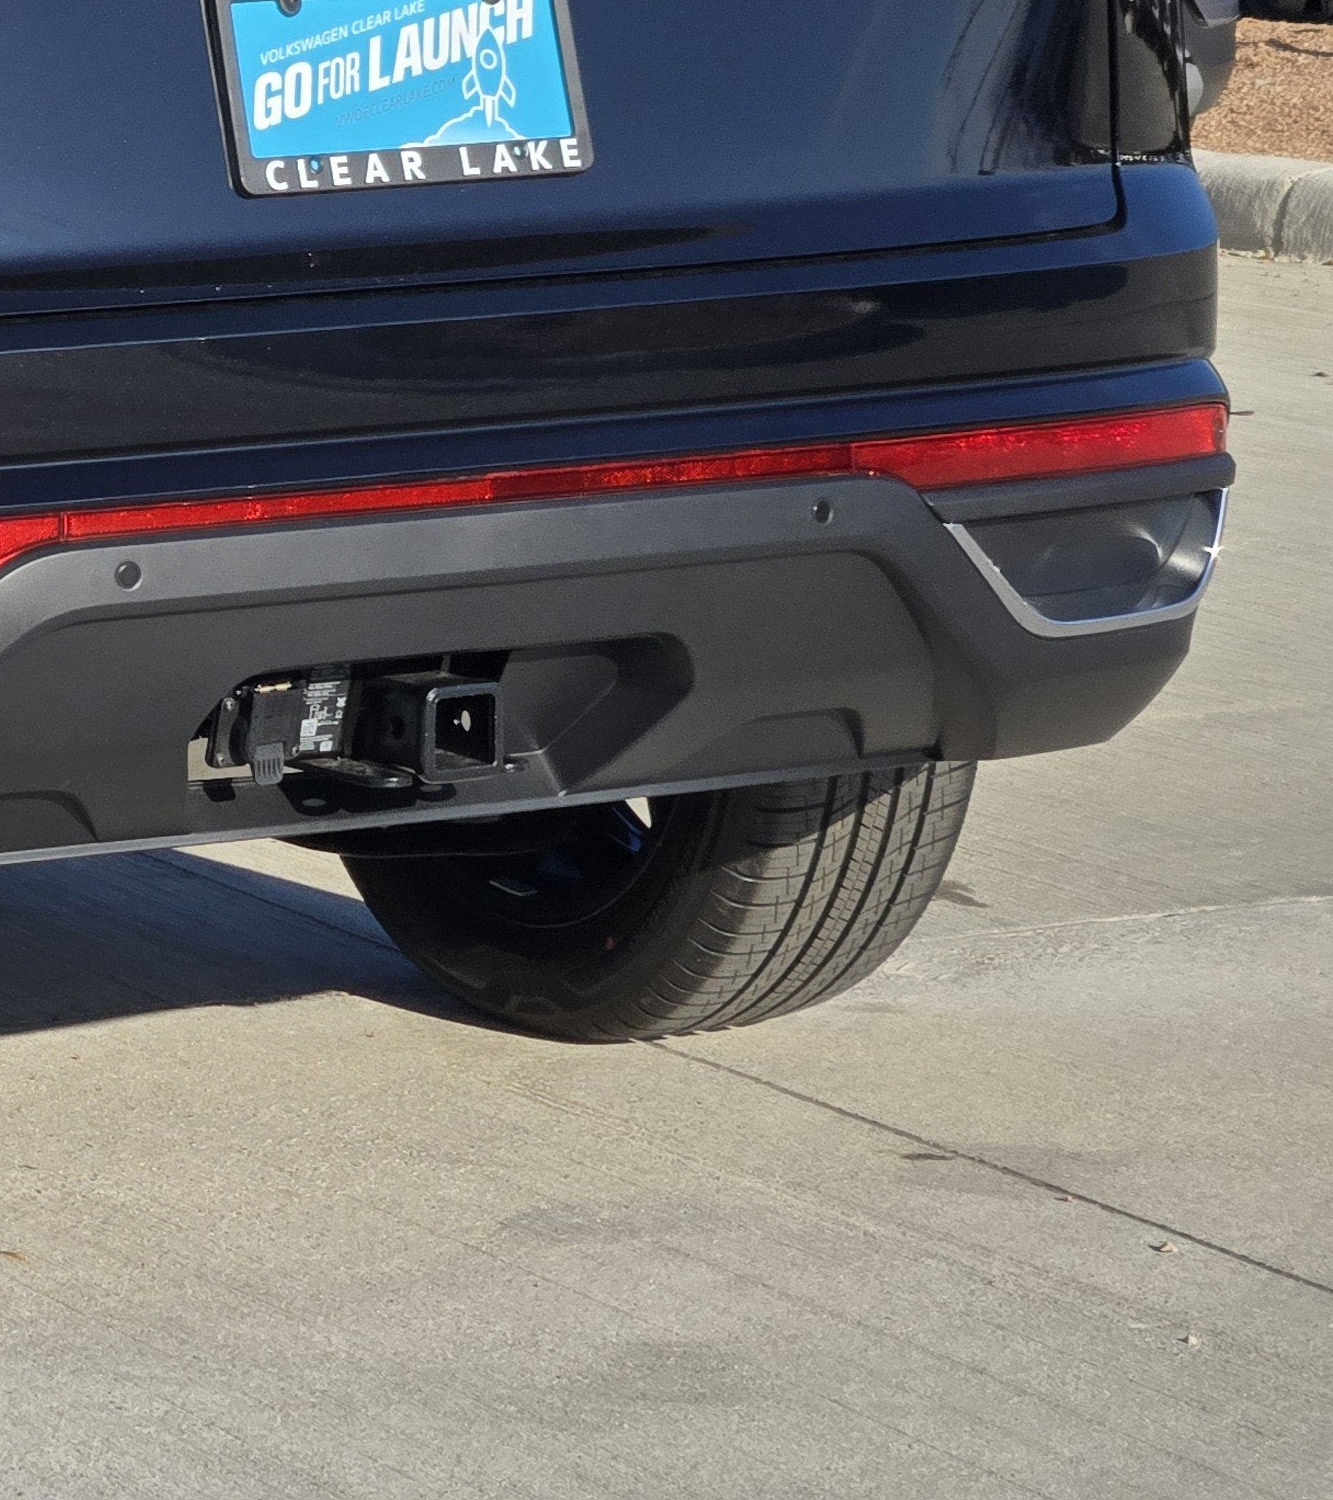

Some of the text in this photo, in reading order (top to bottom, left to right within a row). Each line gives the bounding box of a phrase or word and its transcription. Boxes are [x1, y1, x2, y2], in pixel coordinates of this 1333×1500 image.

[259, 24, 348, 66] VOLKSWAGEN
[351, 10, 391, 35] CLEAR
[253, 61, 313, 131] GO
[317, 51, 361, 105] FOR
[265, 138, 582, 191] CLEAR LAKE
